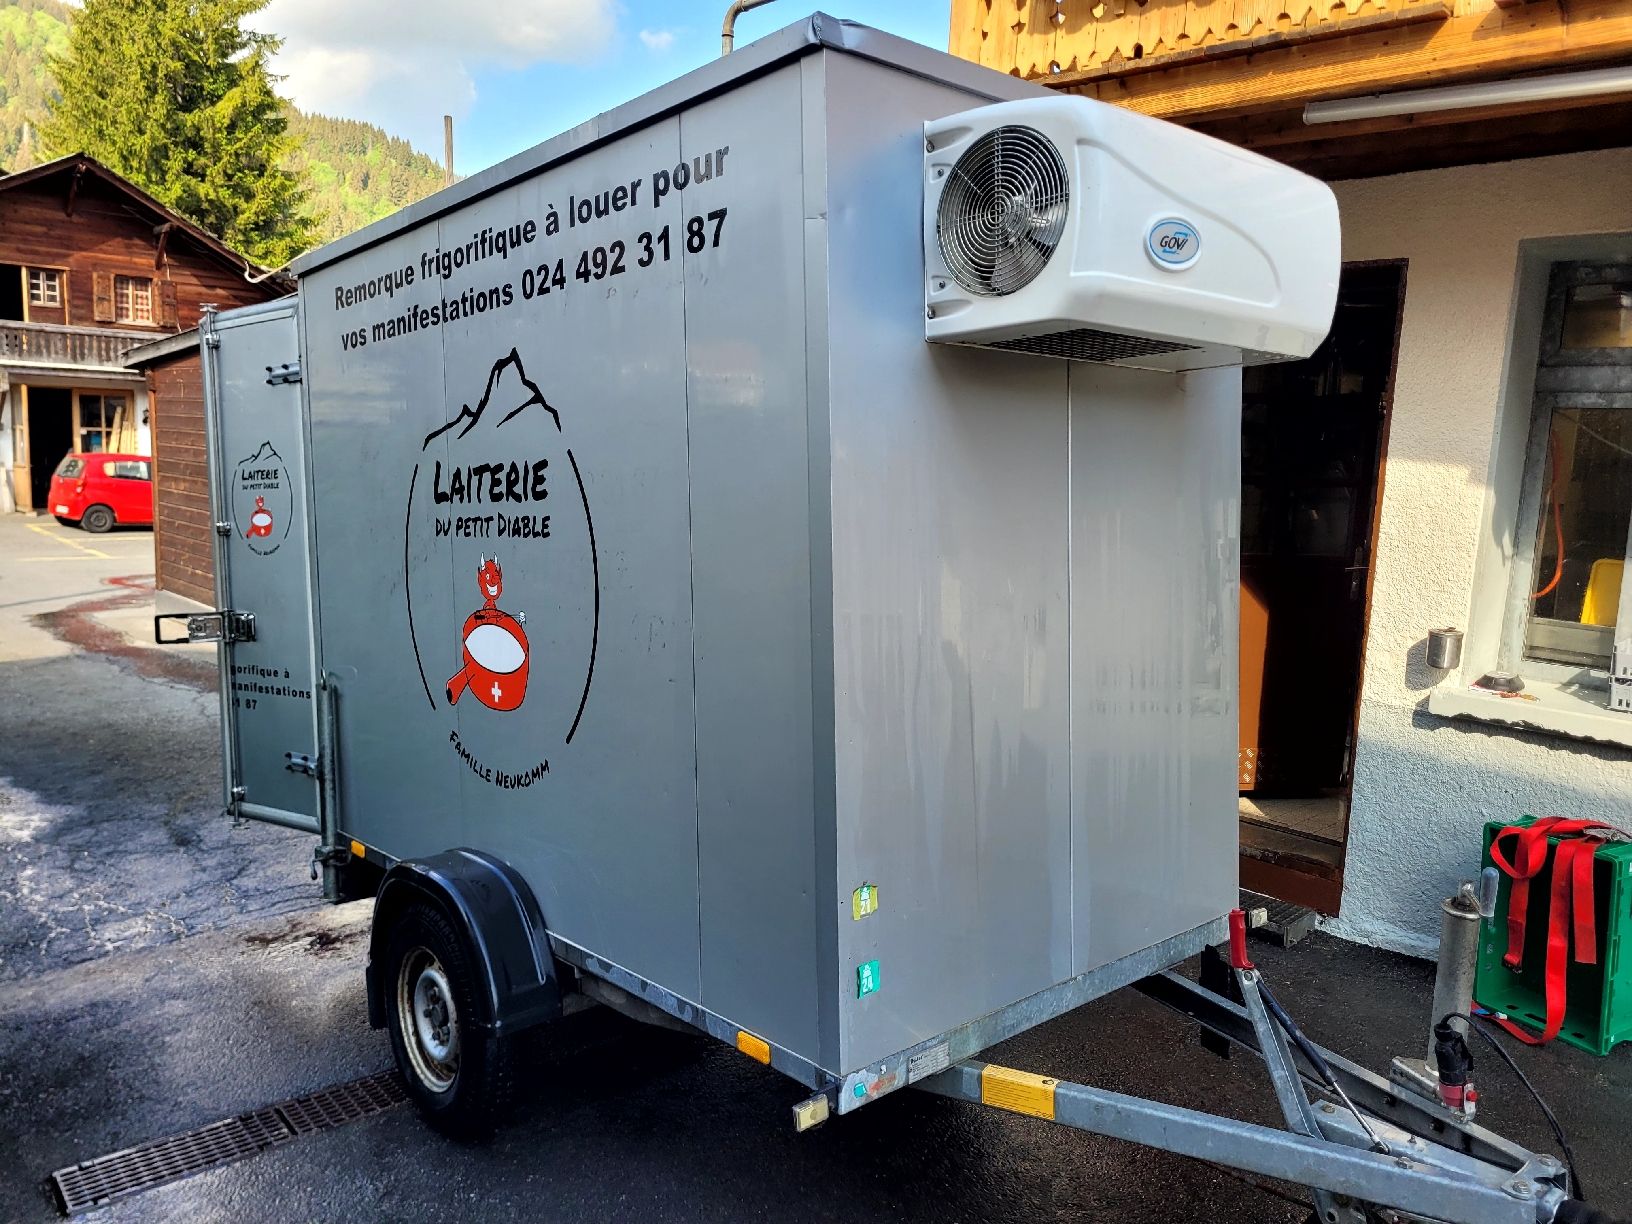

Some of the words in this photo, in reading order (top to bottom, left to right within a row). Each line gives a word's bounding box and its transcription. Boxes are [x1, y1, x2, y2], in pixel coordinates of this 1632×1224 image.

[335, 264, 415, 310] Remorque
[421, 219, 537, 280] frigorifique
[545, 204, 559, 236] à
[569, 179, 641, 228] louer
[653, 145, 730, 208] pour
[341, 320, 367, 351] vos
[373, 281, 513, 342] manifestations
[521, 259, 567, 299] 024
[575, 239, 626, 284] 492
[637, 225, 671, 268] 31
[687, 207, 728, 254] 87
[242, 469, 278, 480] LAITERIE
[433, 459, 549, 504] LAITERIE
[436, 517, 451, 537] DU
[456, 516, 494, 538] PETIT
[498, 512, 550, 538] DIABLE
[284, 668, 290, 679] à
[245, 699, 257, 710] 87
[450, 730, 491, 783] FAMILLE
[496, 759, 549, 789] NEUKOMM
